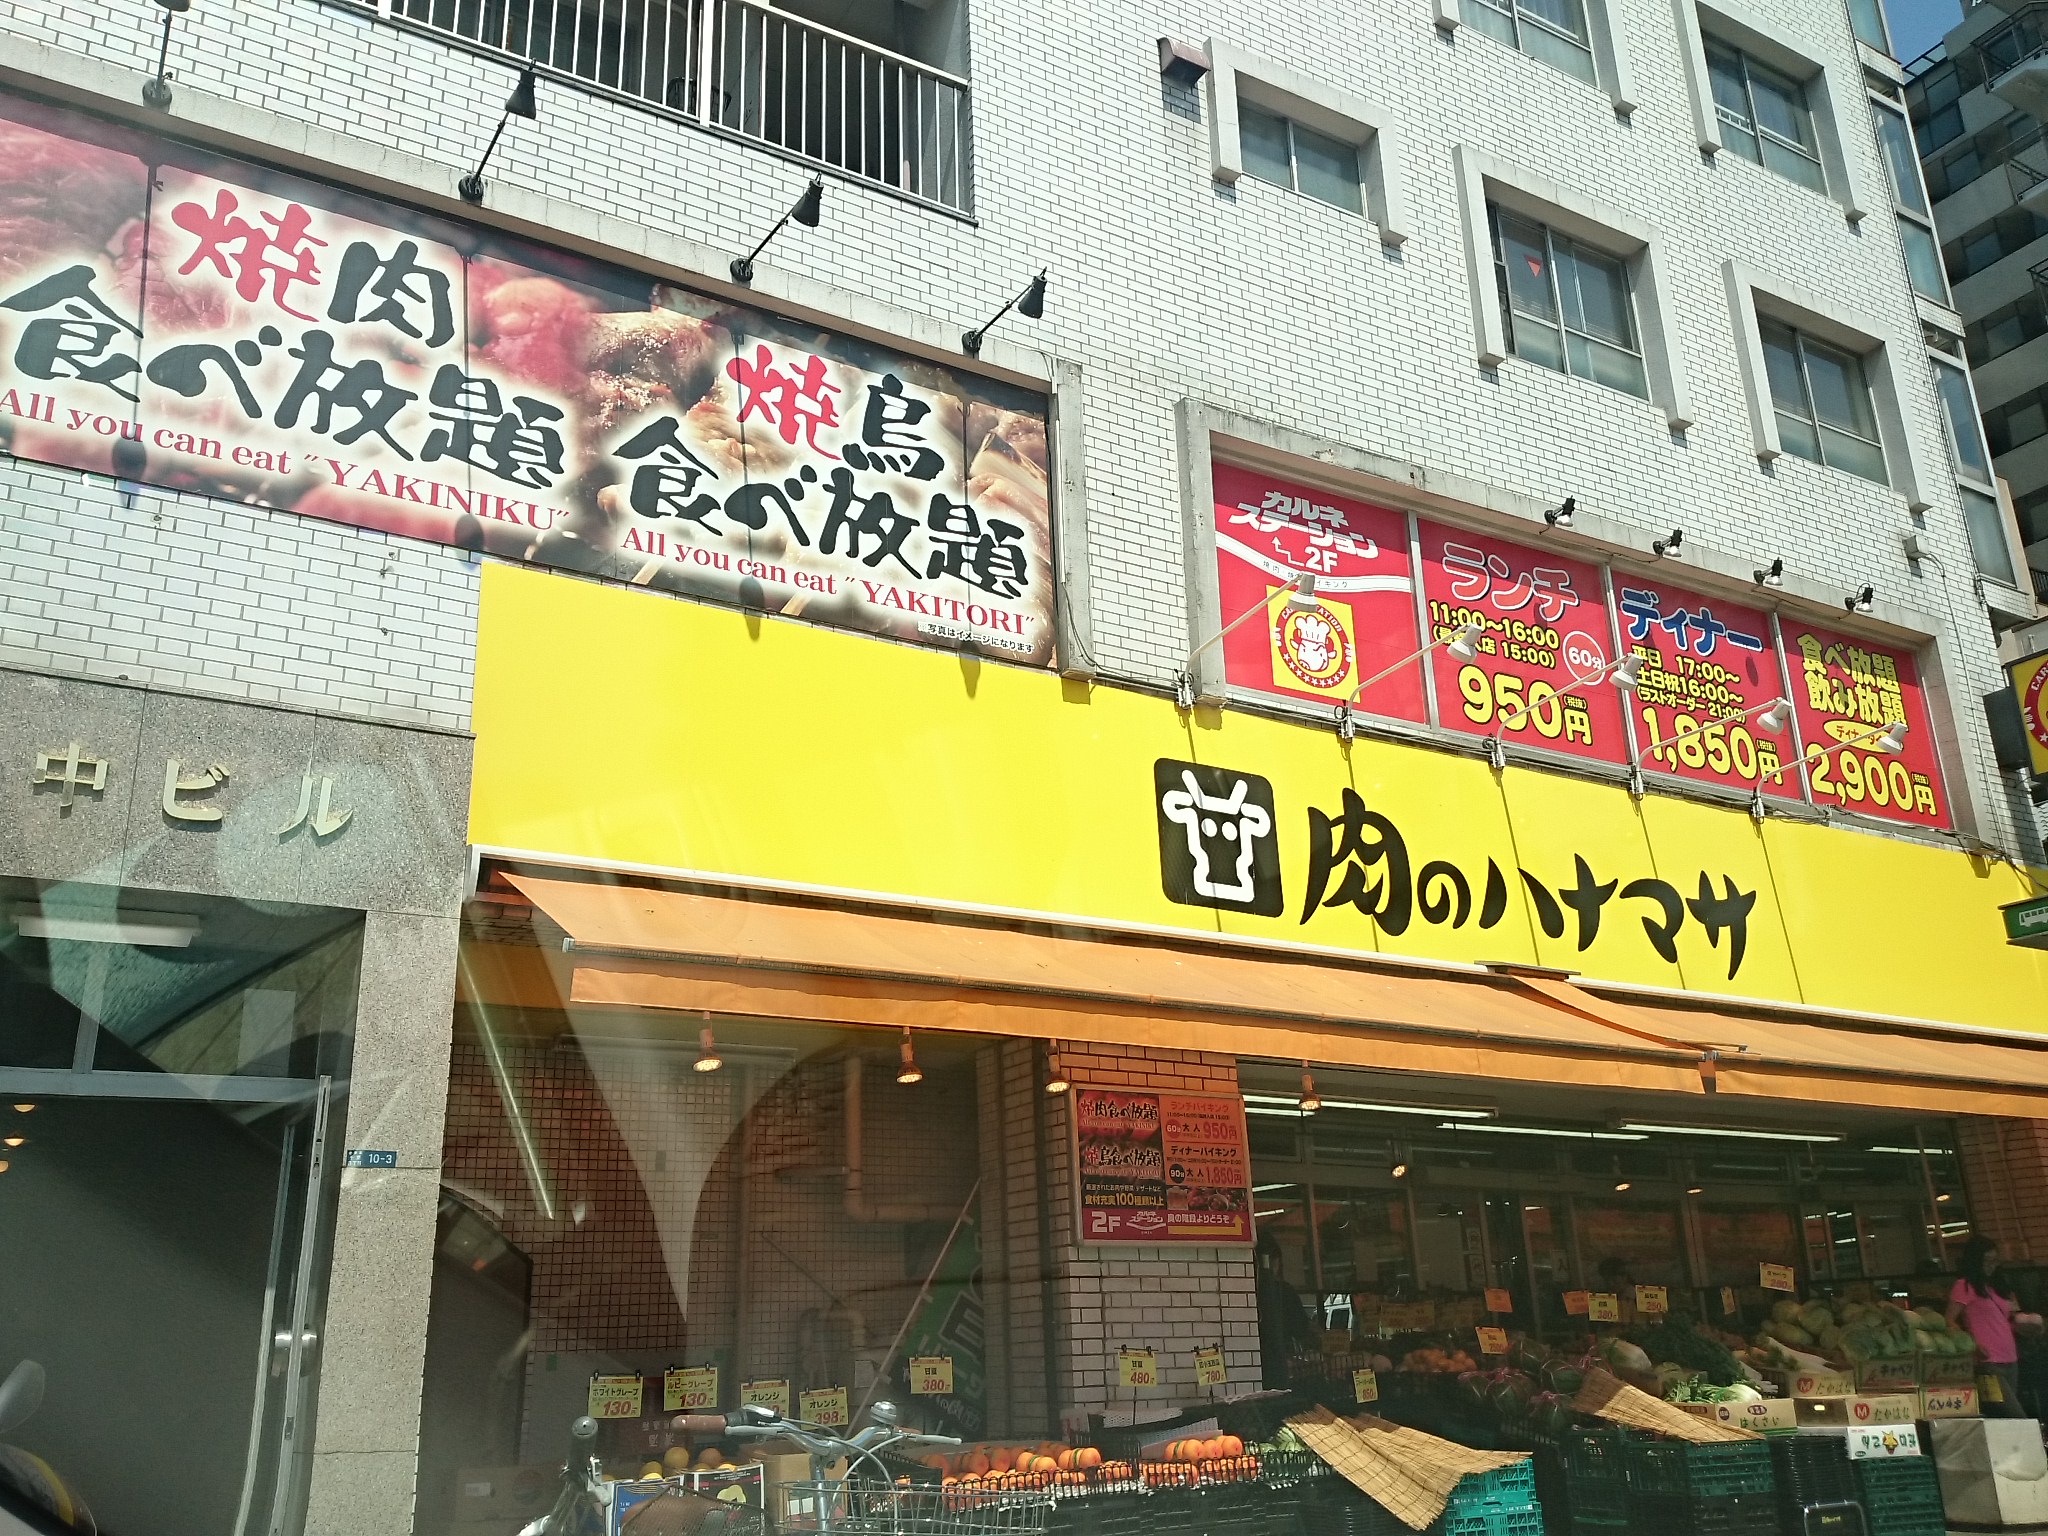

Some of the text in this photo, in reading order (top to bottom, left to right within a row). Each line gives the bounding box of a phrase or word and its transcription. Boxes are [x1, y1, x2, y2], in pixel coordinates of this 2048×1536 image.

[171, 188, 456, 348] 焼肉
[0, 264, 565, 489] 食べ放題
[0, 387, 56, 425] All
[66, 408, 144, 443] you
[153, 428, 223, 461] can
[231, 445, 292, 475] eat
[726, 344, 945, 481] 焼鳥
[612, 415, 1028, 600] 食べ放題
[1228, 502, 1379, 559] ステーション
[1261, 490, 1349, 528] カルネ
[620, 526, 666, 557] All
[673, 543, 730, 572] you
[736, 558, 787, 585] can
[793, 569, 838, 595] eat
[1304, 546, 1338, 573] 2F
[1441, 541, 1581, 623] ランチ
[1432, 624, 1497, 656] (最店
[1620, 586, 1763, 655] ディナー
[1797, 633, 1901, 694] 食べ放題
[2031, 662, 2048, 691] CAR
[1804, 671, 1909, 732] 飲み放題
[33, 742, 354, 838] 中ビル
[1299, 787, 1757, 982] 肉のハナマサ
[368, 1153, 393, 1164] 10-3
[1091, 1211, 1121, 1233] 2F
[750, 1392, 780, 1401] オレンジ
[809, 1398, 838, 1408] オレンジ
